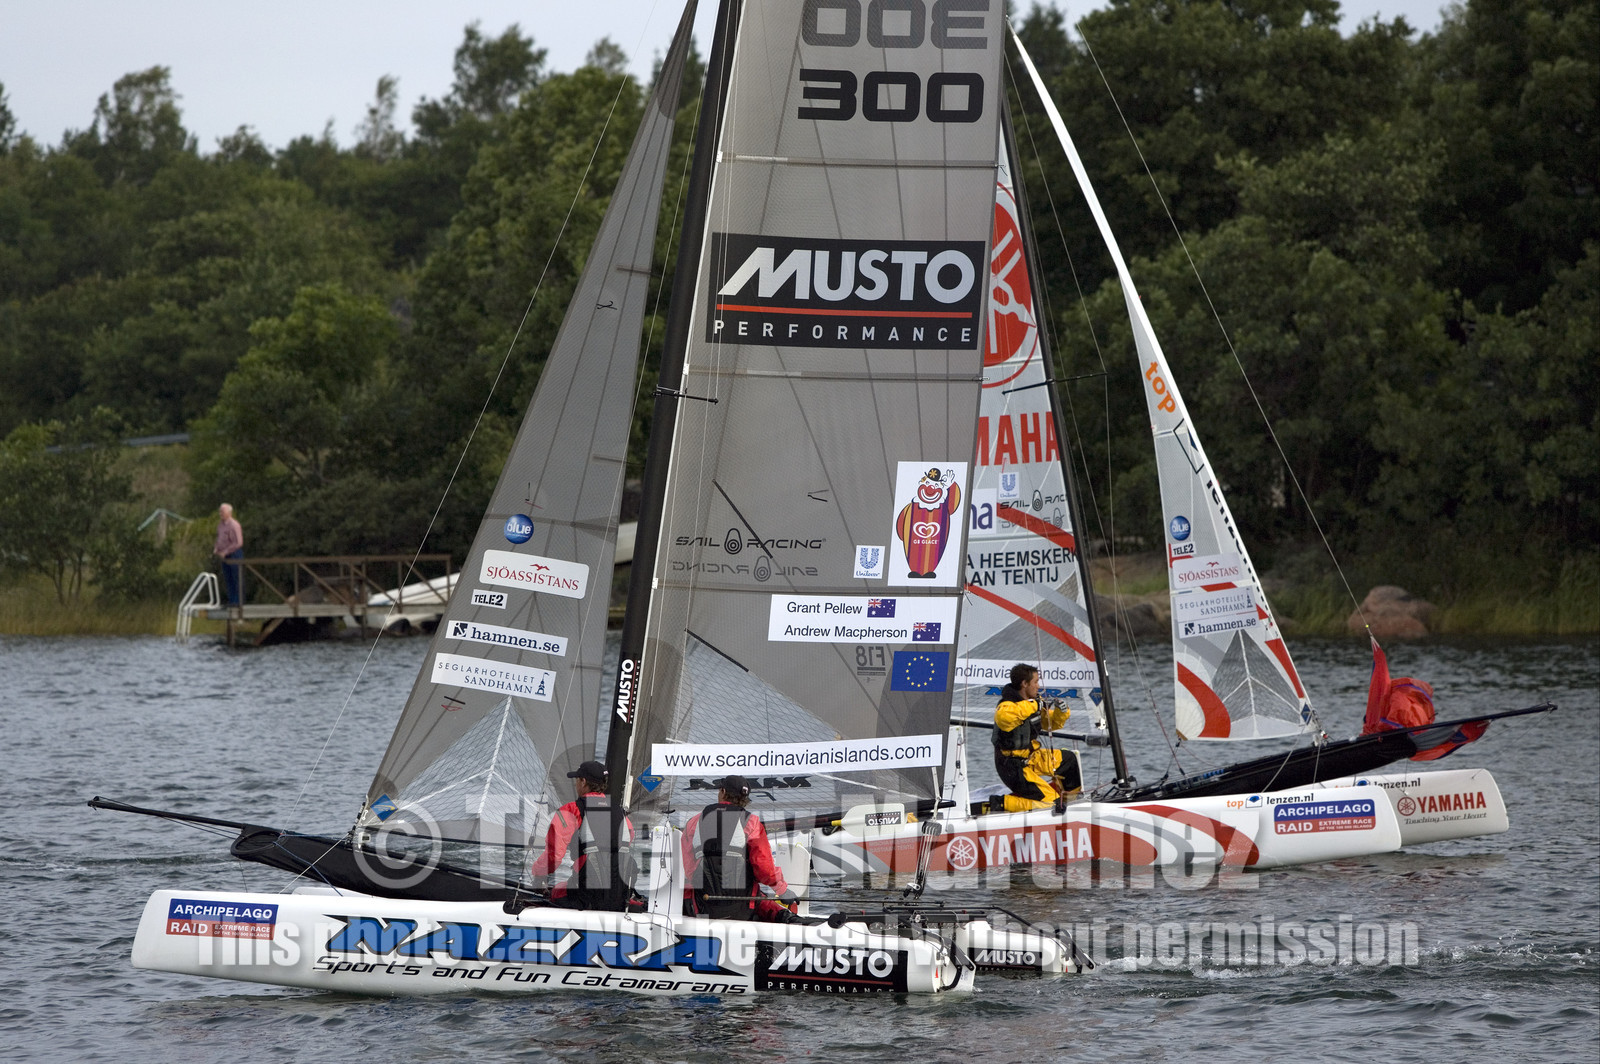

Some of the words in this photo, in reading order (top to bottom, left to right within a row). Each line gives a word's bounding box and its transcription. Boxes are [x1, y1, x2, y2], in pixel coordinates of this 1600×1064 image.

[798, 68, 984, 123] 300
[718, 247, 975, 304] MUSTO
[713, 319, 972, 343] PERFORMANCE
[1145, 361, 1176, 414] top
[506, 520, 532, 535] blue
[675, 536, 720, 547] SAIL
[746, 538, 823, 549] RACING
[1173, 544, 1194, 555] TELE2
[487, 565, 580, 591] SJÖASSISTANS
[1001, 566, 1059, 585] TENTIJ
[1178, 566, 1239, 584] SJÖASSISTANS
[474, 594, 504, 607] TELE2
[787, 602, 821, 615] Grant
[824, 603, 863, 615] Pellew
[1200, 602, 1245, 616] SANDHAMN
[784, 625, 831, 638] Andrew
[834, 626, 908, 640] Macpherson
[1198, 617, 1257, 634] hamnen.se
[470, 627, 560, 653] hamnen.se
[438, 661, 535, 684] SEGLARHOTELLET
[464, 675, 533, 695] SANDHAMN
[616, 659, 635, 723] MUSTO
[665, 742, 931, 768] www.scandinavianislands.com
[1226, 799, 1244, 809] top
[1266, 793, 1314, 805] lenzen.nl
[1416, 791, 1487, 813] YAMAHA
[1276, 803, 1372, 818] ARCHIPELAGO
[1277, 821, 1314, 833] RAID
[1404, 817, 1440, 825] Touching
[980, 826, 1094, 866] YAMAHA
[173, 904, 273, 919] ARCHIPELAGO
[170, 922, 208, 934] RAID
[768, 946, 894, 978] MUSTO
[975, 949, 1036, 965] MUSTO
[312, 956, 424, 976] Sports
[432, 966, 491, 980] and
[495, 967, 551, 984] Fun
[561, 971, 748, 994] Catamarans
